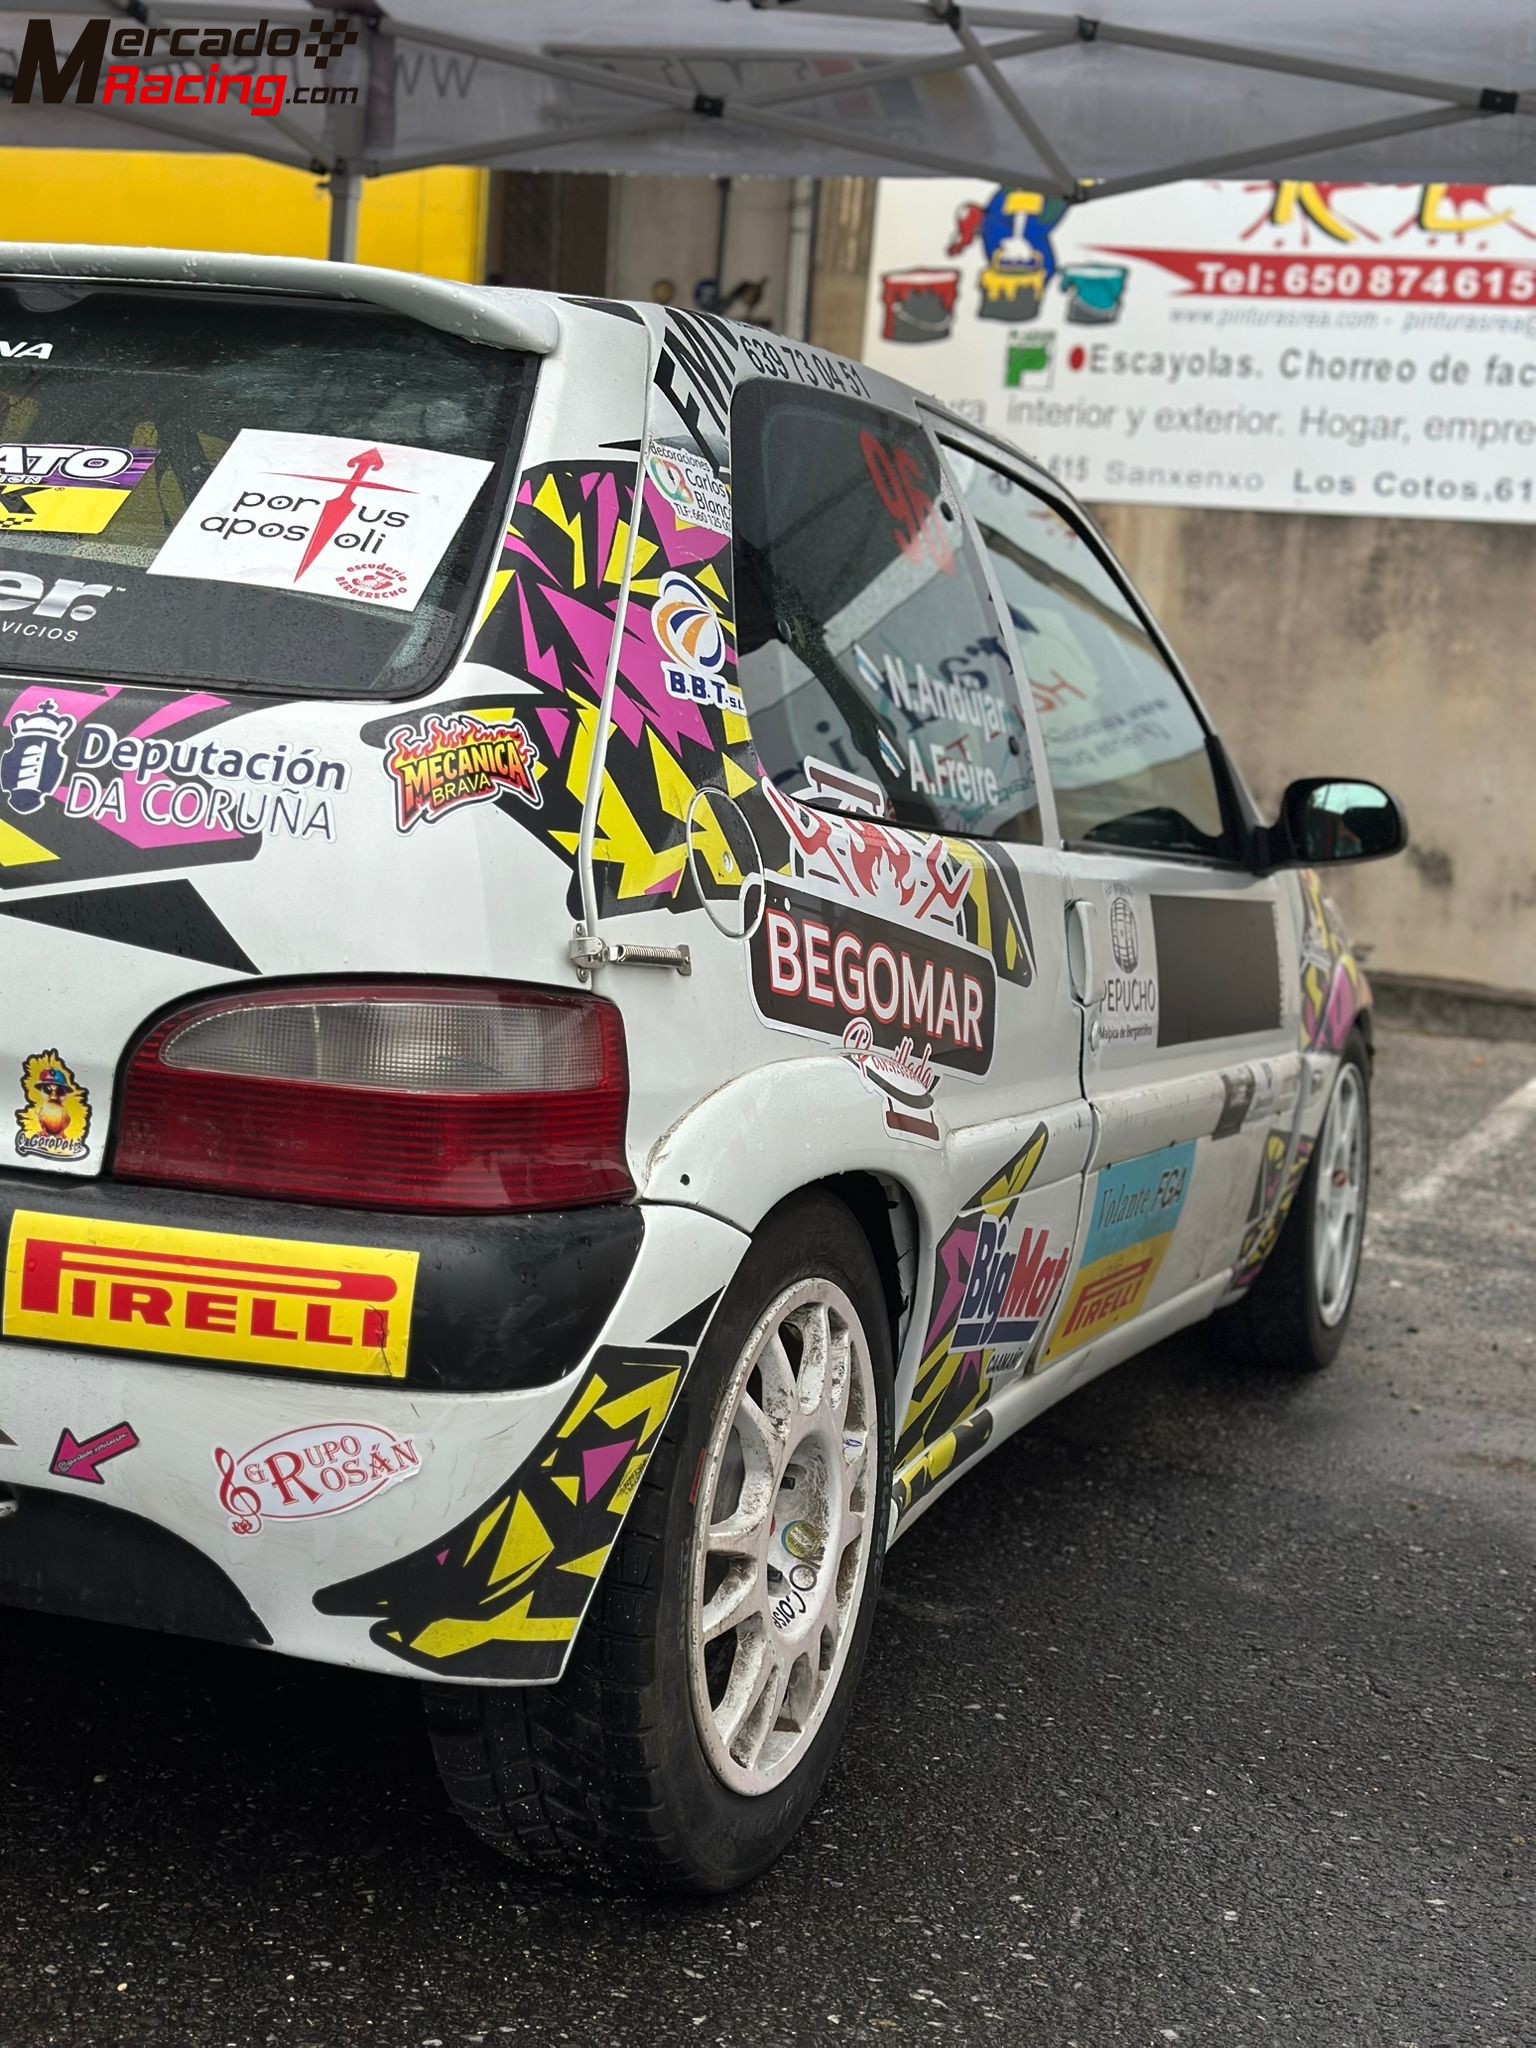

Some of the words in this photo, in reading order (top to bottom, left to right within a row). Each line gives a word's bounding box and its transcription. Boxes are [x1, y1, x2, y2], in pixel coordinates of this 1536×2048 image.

[1198, 263, 1273, 294] Tel:
[1284, 265, 1362, 296] 650
[1368, 266, 1447, 297] 874
[740, 335, 790, 379] 639
[781, 345, 819, 386] 73
[812, 354, 847, 393] 04
[837, 360, 871, 399] 51
[1090, 343, 1263, 381] Escayolas.
[1279, 348, 1416, 385] Chorreo
[1429, 352, 1470, 386] de
[1007, 395, 1116, 427] interior
[1126, 406, 1146, 438] y
[1153, 403, 1285, 437] exterior.
[1299, 406, 1410, 448] Hogar,
[685, 468, 727, 498] Carlos
[1291, 467, 1357, 497] Los
[79, 725, 346, 791] Deputación
[431, 772, 489, 807] BRAVA
[908, 738, 998, 806] A.Freire
[66, 776, 126, 821] DA
[143, 781, 332, 841] CORUÑA
[766, 907, 984, 1052] BEGOMAR
[1097, 1183, 1151, 1231] Volante
[21, 1238, 398, 1348] PIRELLI
[960, 1220, 1070, 1342] BigMat
[1063, 1257, 1153, 1338] PIRELLI
